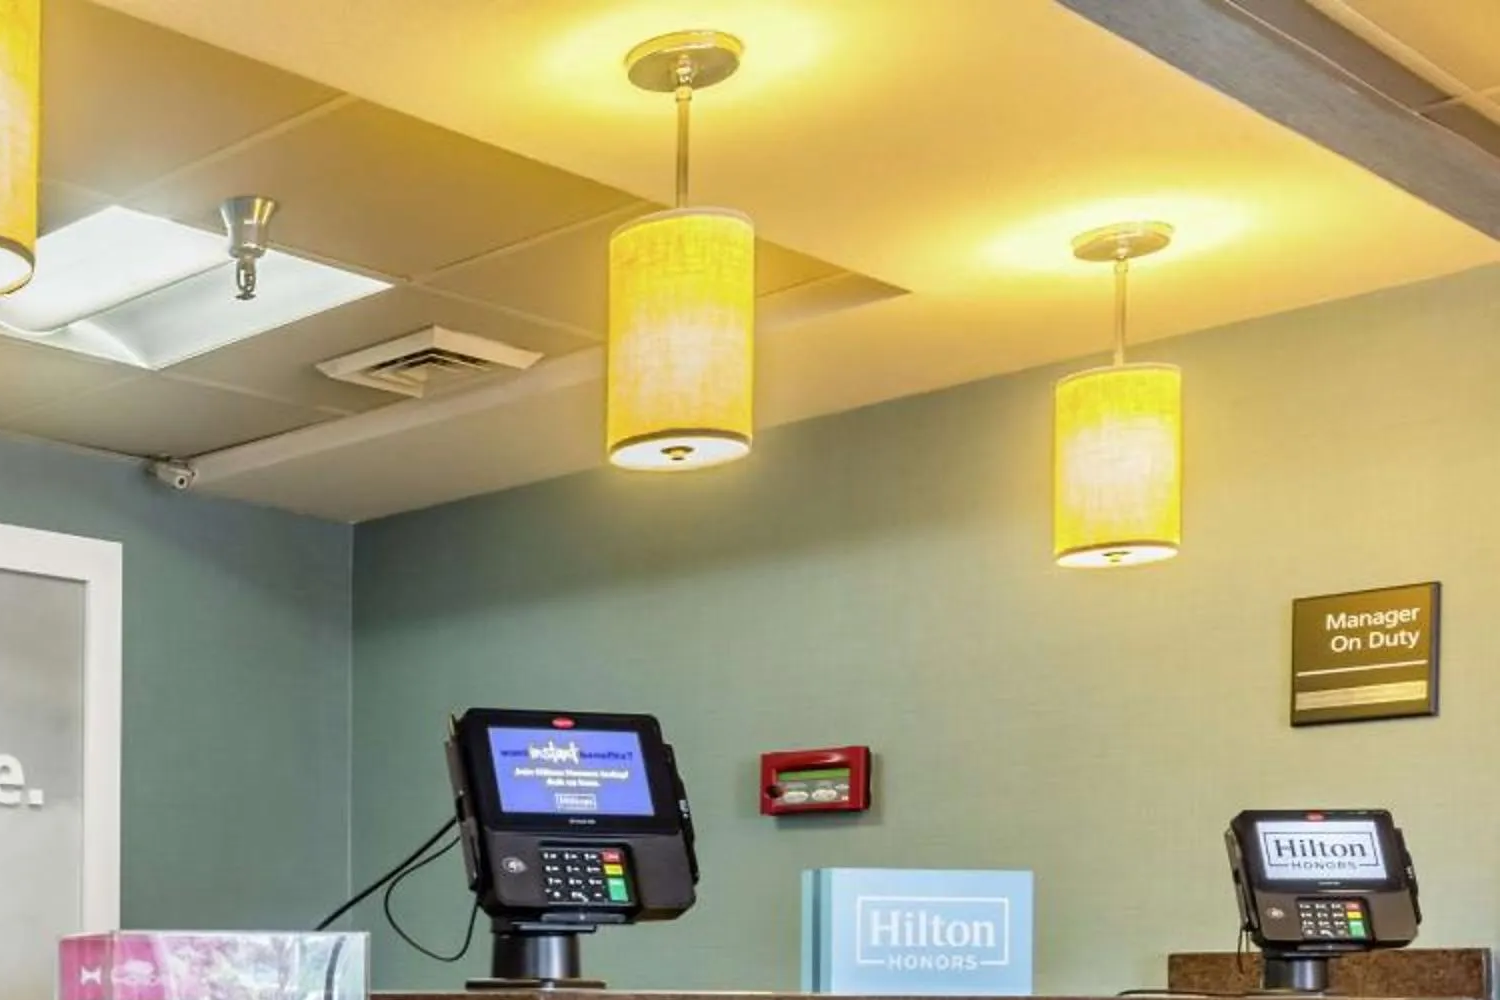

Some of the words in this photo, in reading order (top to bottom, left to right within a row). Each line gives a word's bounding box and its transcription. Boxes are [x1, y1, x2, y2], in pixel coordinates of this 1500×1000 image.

[1325, 606, 1421, 631] Manager
[1330, 634, 1362, 653] On
[1368, 629, 1421, 649] Duty
[1273, 838, 1367, 858] Hilton
[1290, 860, 1358, 871] HONORS
[868, 908, 998, 949] Hilton
[886, 953, 980, 971] HONORS
